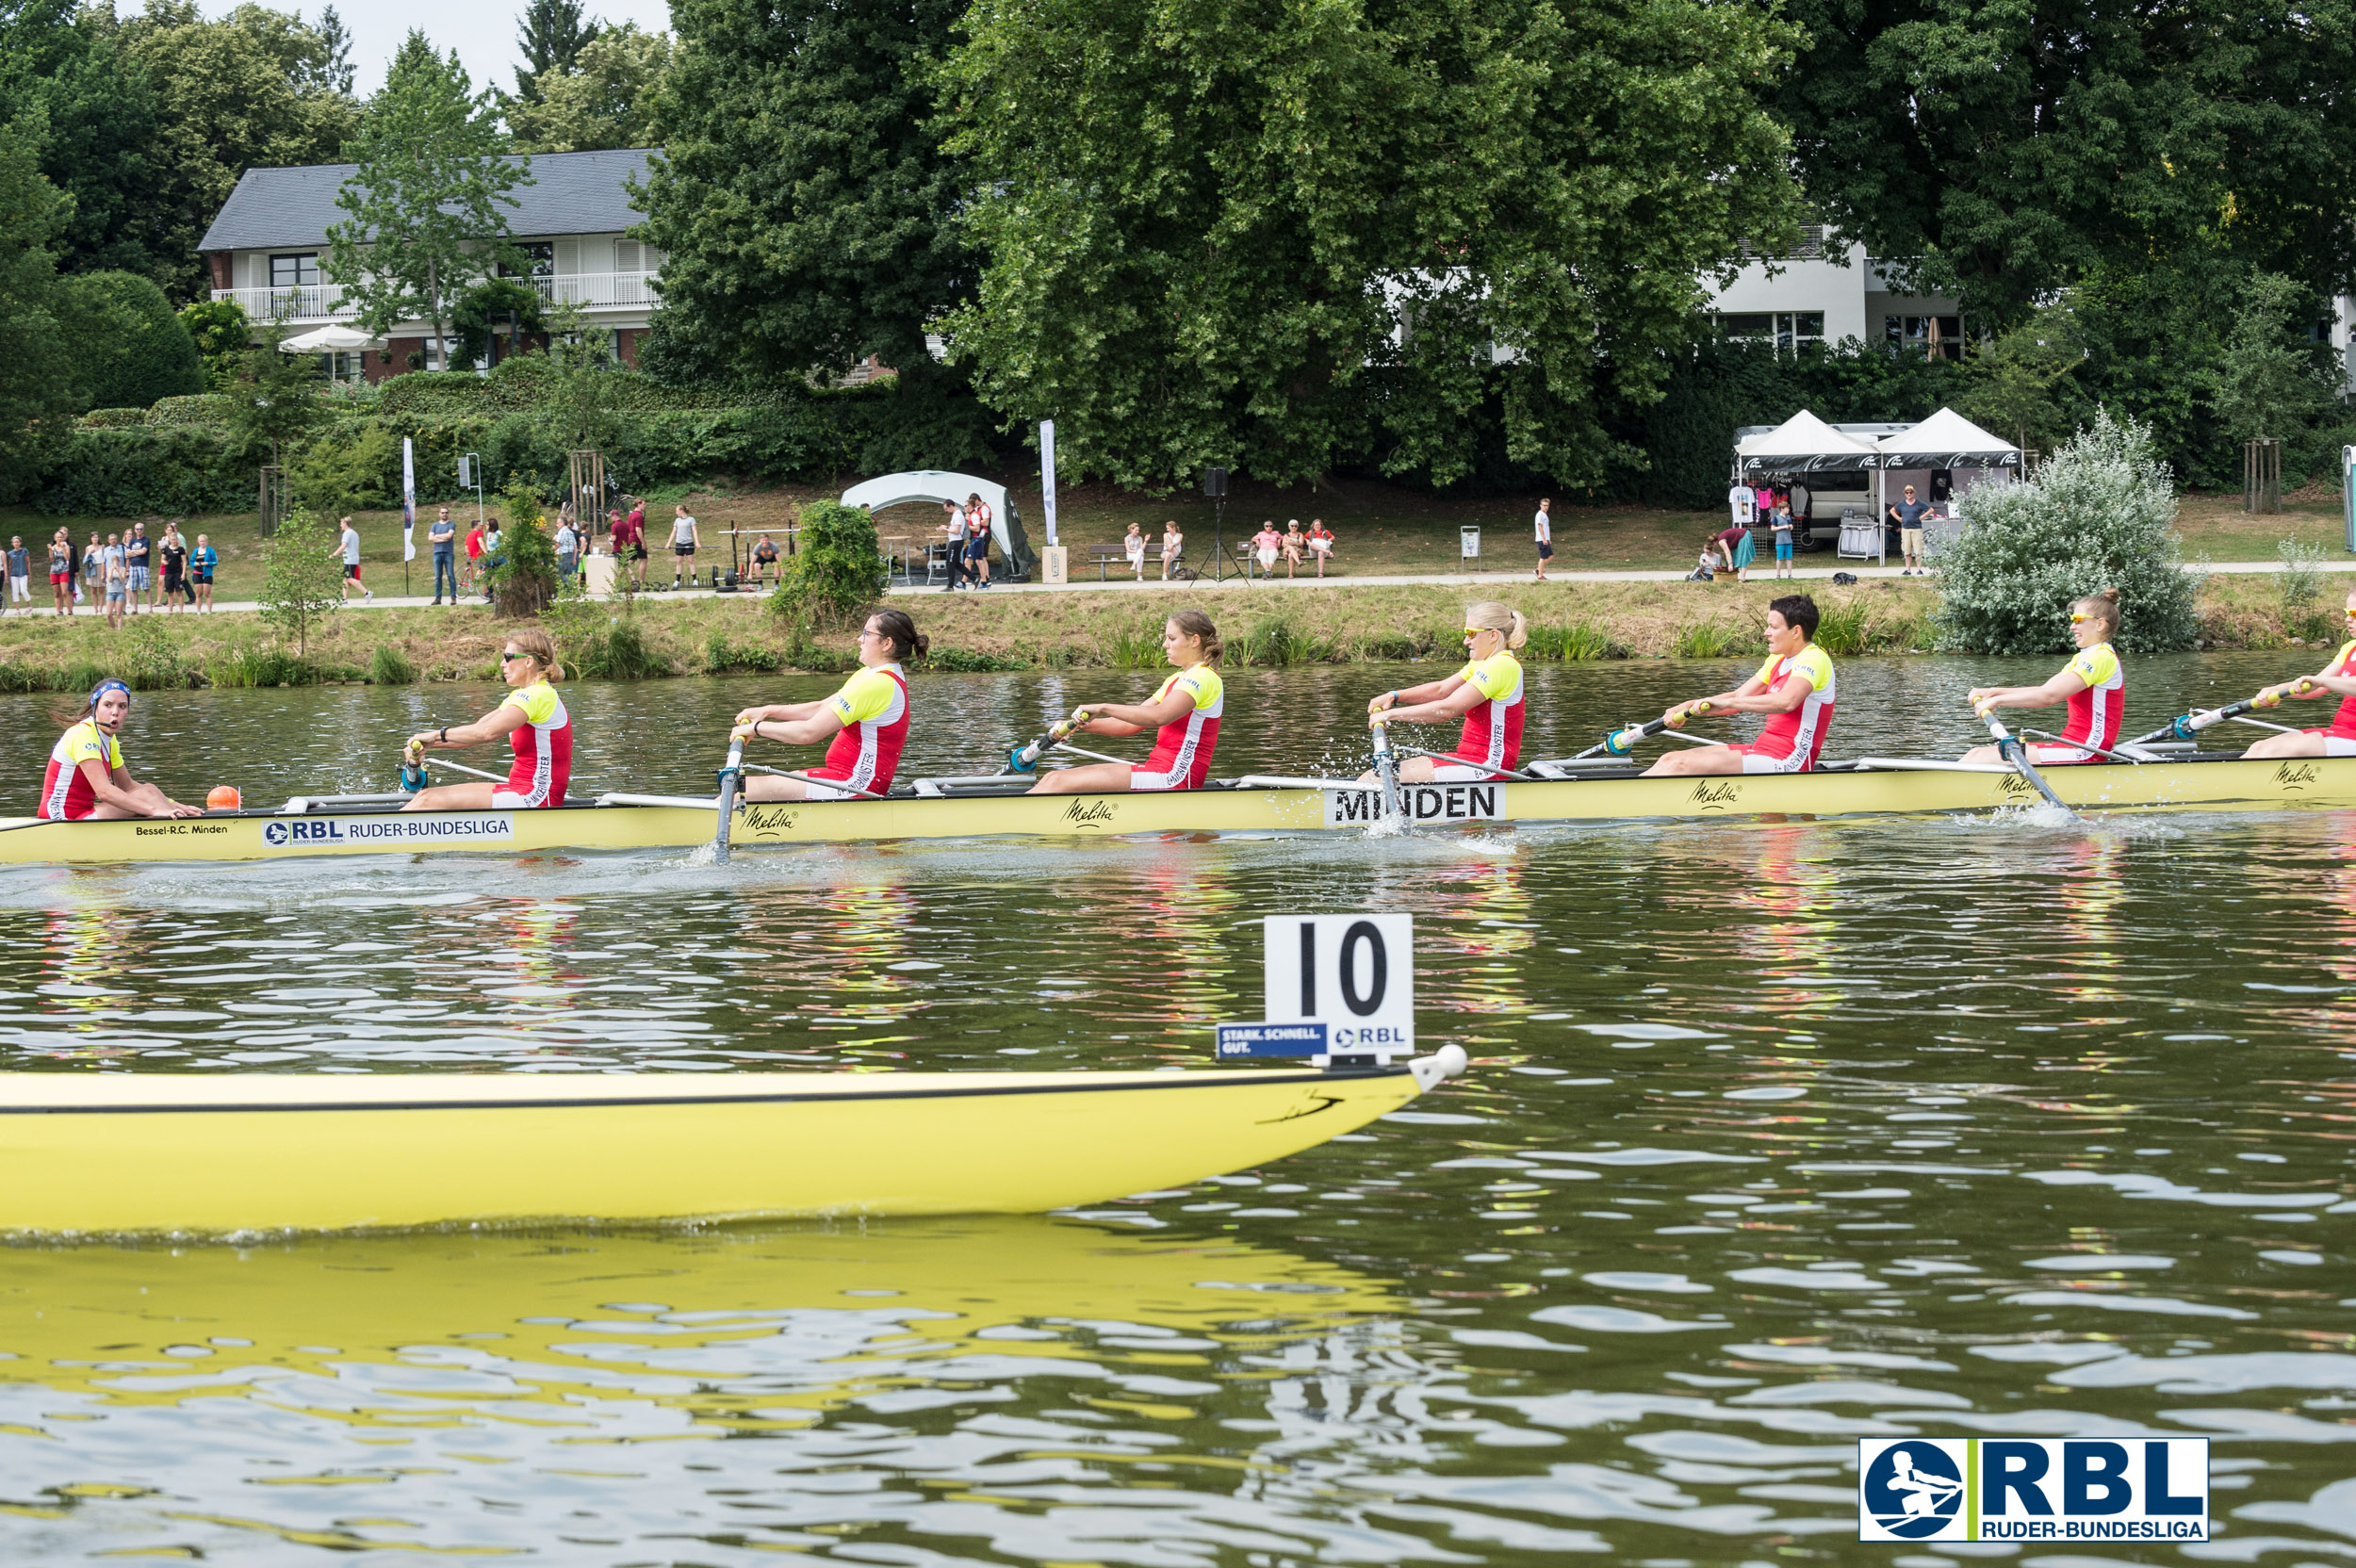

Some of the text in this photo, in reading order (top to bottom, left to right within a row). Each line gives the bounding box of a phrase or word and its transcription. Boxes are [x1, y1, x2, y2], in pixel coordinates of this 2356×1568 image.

[136, 825, 228, 836] Bessel-R.C. Minden
[292, 821, 343, 839] RBL
[350, 820, 509, 838] RUDER-BUNDESLIGA
[1301, 921, 1387, 1018] 10
[1222, 1027, 1321, 1041] STARK. SCHNELL.
[1360, 1028, 1405, 1043] RBL
[1222, 1042, 1251, 1054] GUT.
